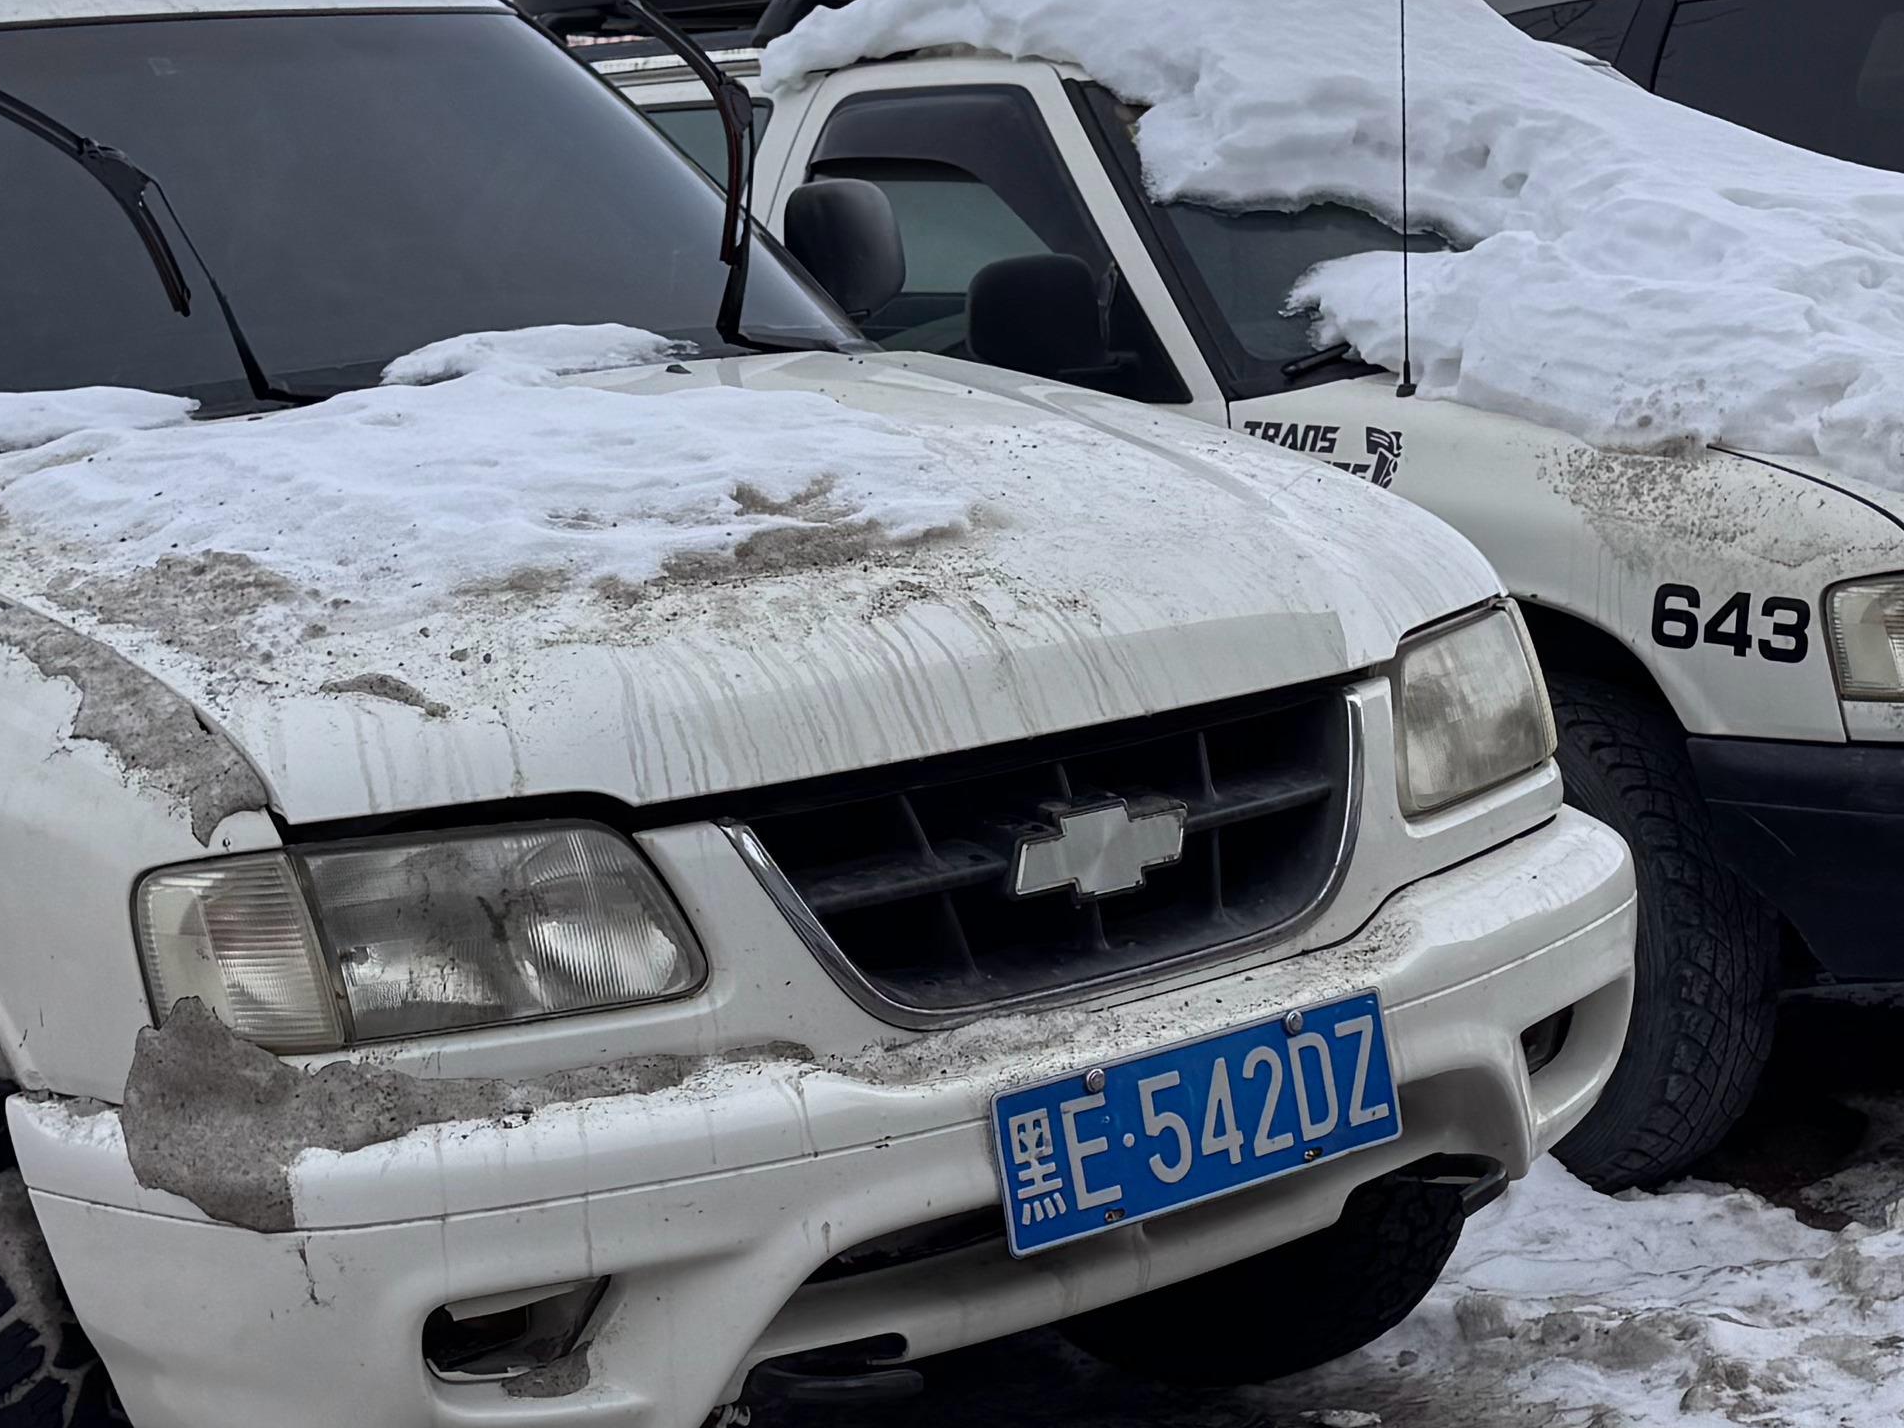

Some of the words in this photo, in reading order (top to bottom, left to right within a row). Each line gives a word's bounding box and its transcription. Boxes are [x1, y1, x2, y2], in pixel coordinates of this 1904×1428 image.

[1244, 420, 1341, 454] TRANS
[1651, 582, 1811, 664] 643
[1007, 1013, 1391, 1226] 黑E·542DZ
